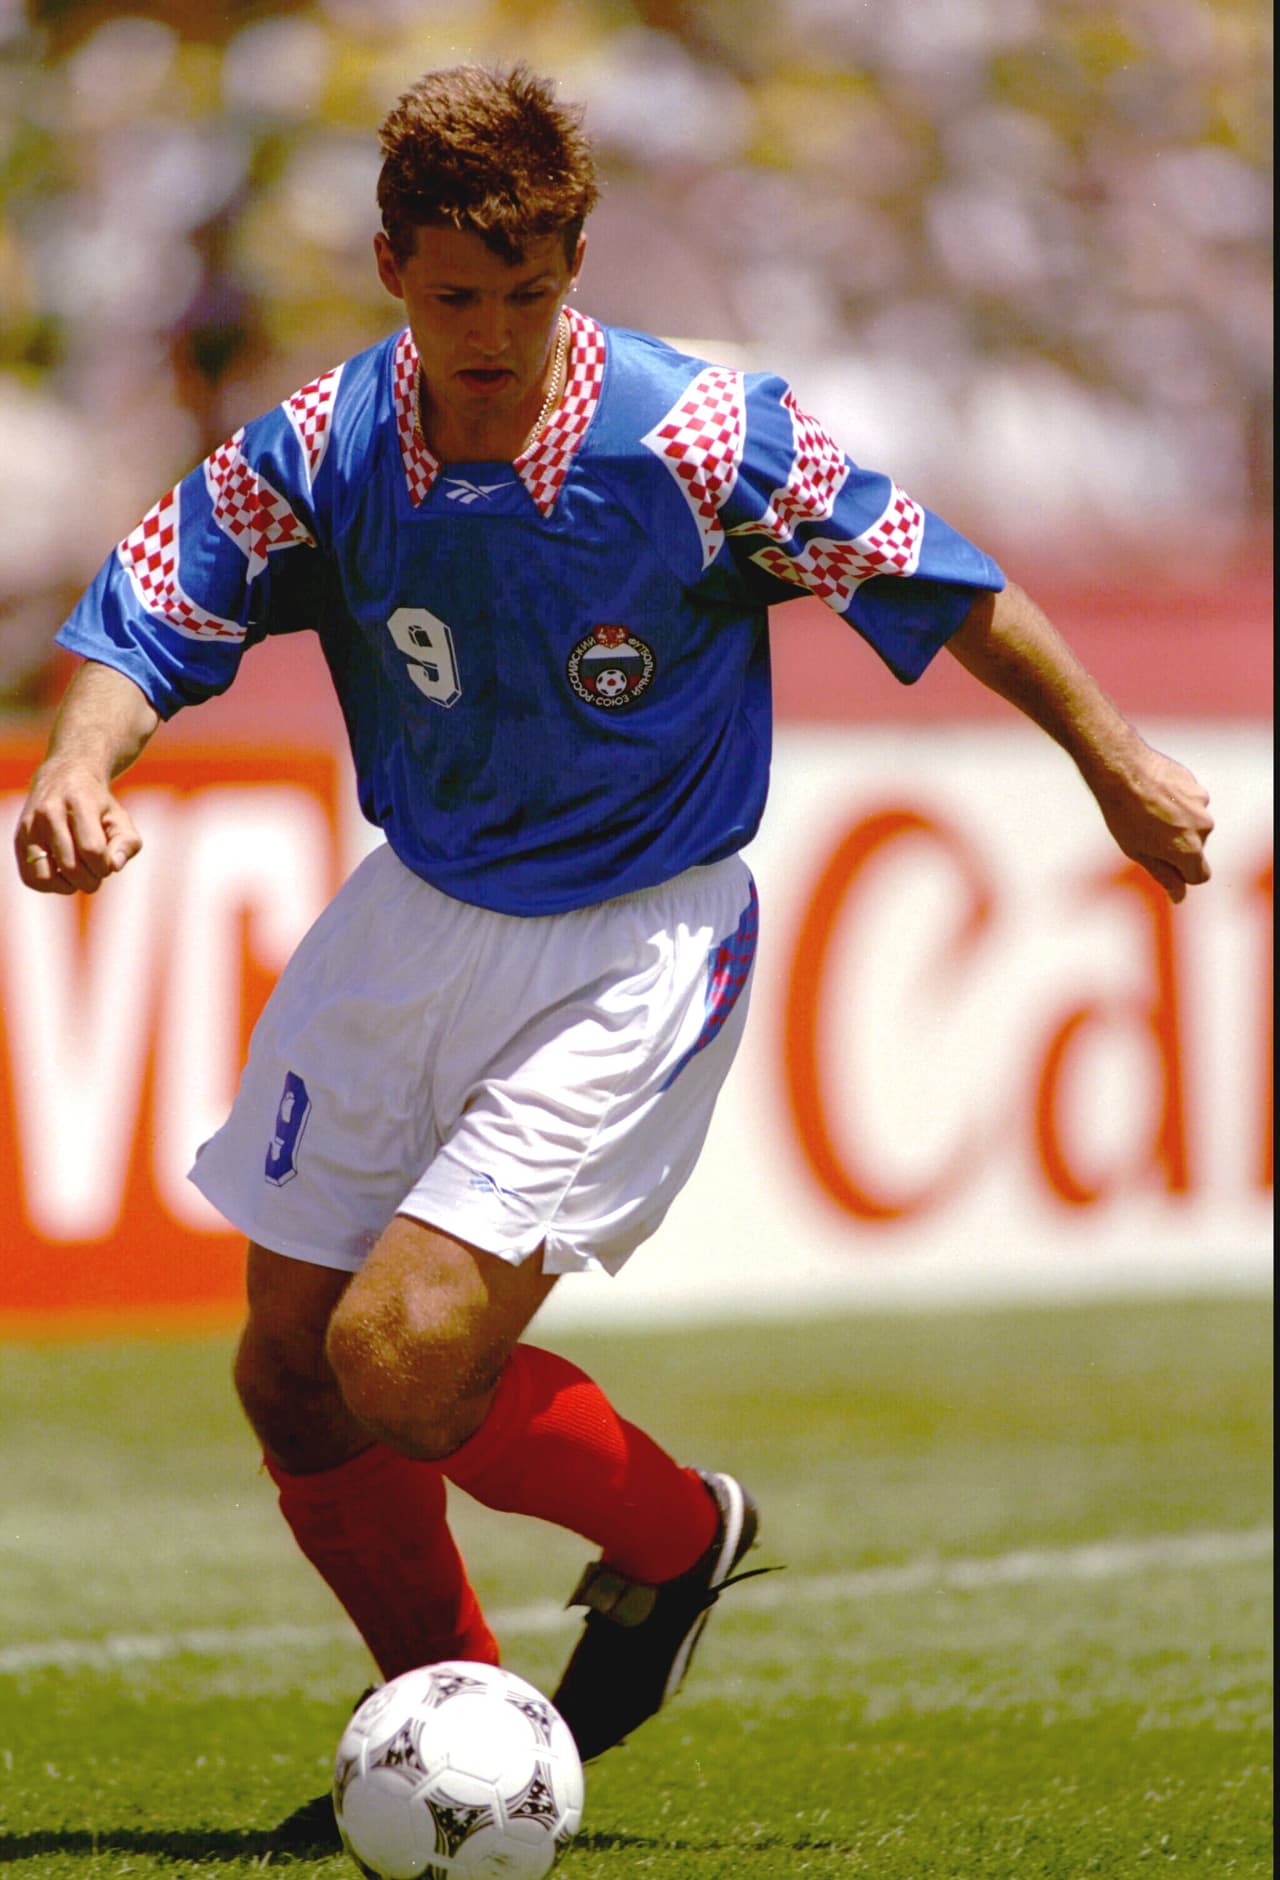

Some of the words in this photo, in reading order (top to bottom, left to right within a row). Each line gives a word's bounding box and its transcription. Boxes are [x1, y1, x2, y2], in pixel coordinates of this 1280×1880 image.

[387, 608, 462, 709] 9
[568, 636, 597, 702] РОССИЙСКИЙ
[596, 695, 630, 707] СОЮЗ
[783, 805, 1274, 1224] Ca
[265, 1070, 312, 1187] 9
